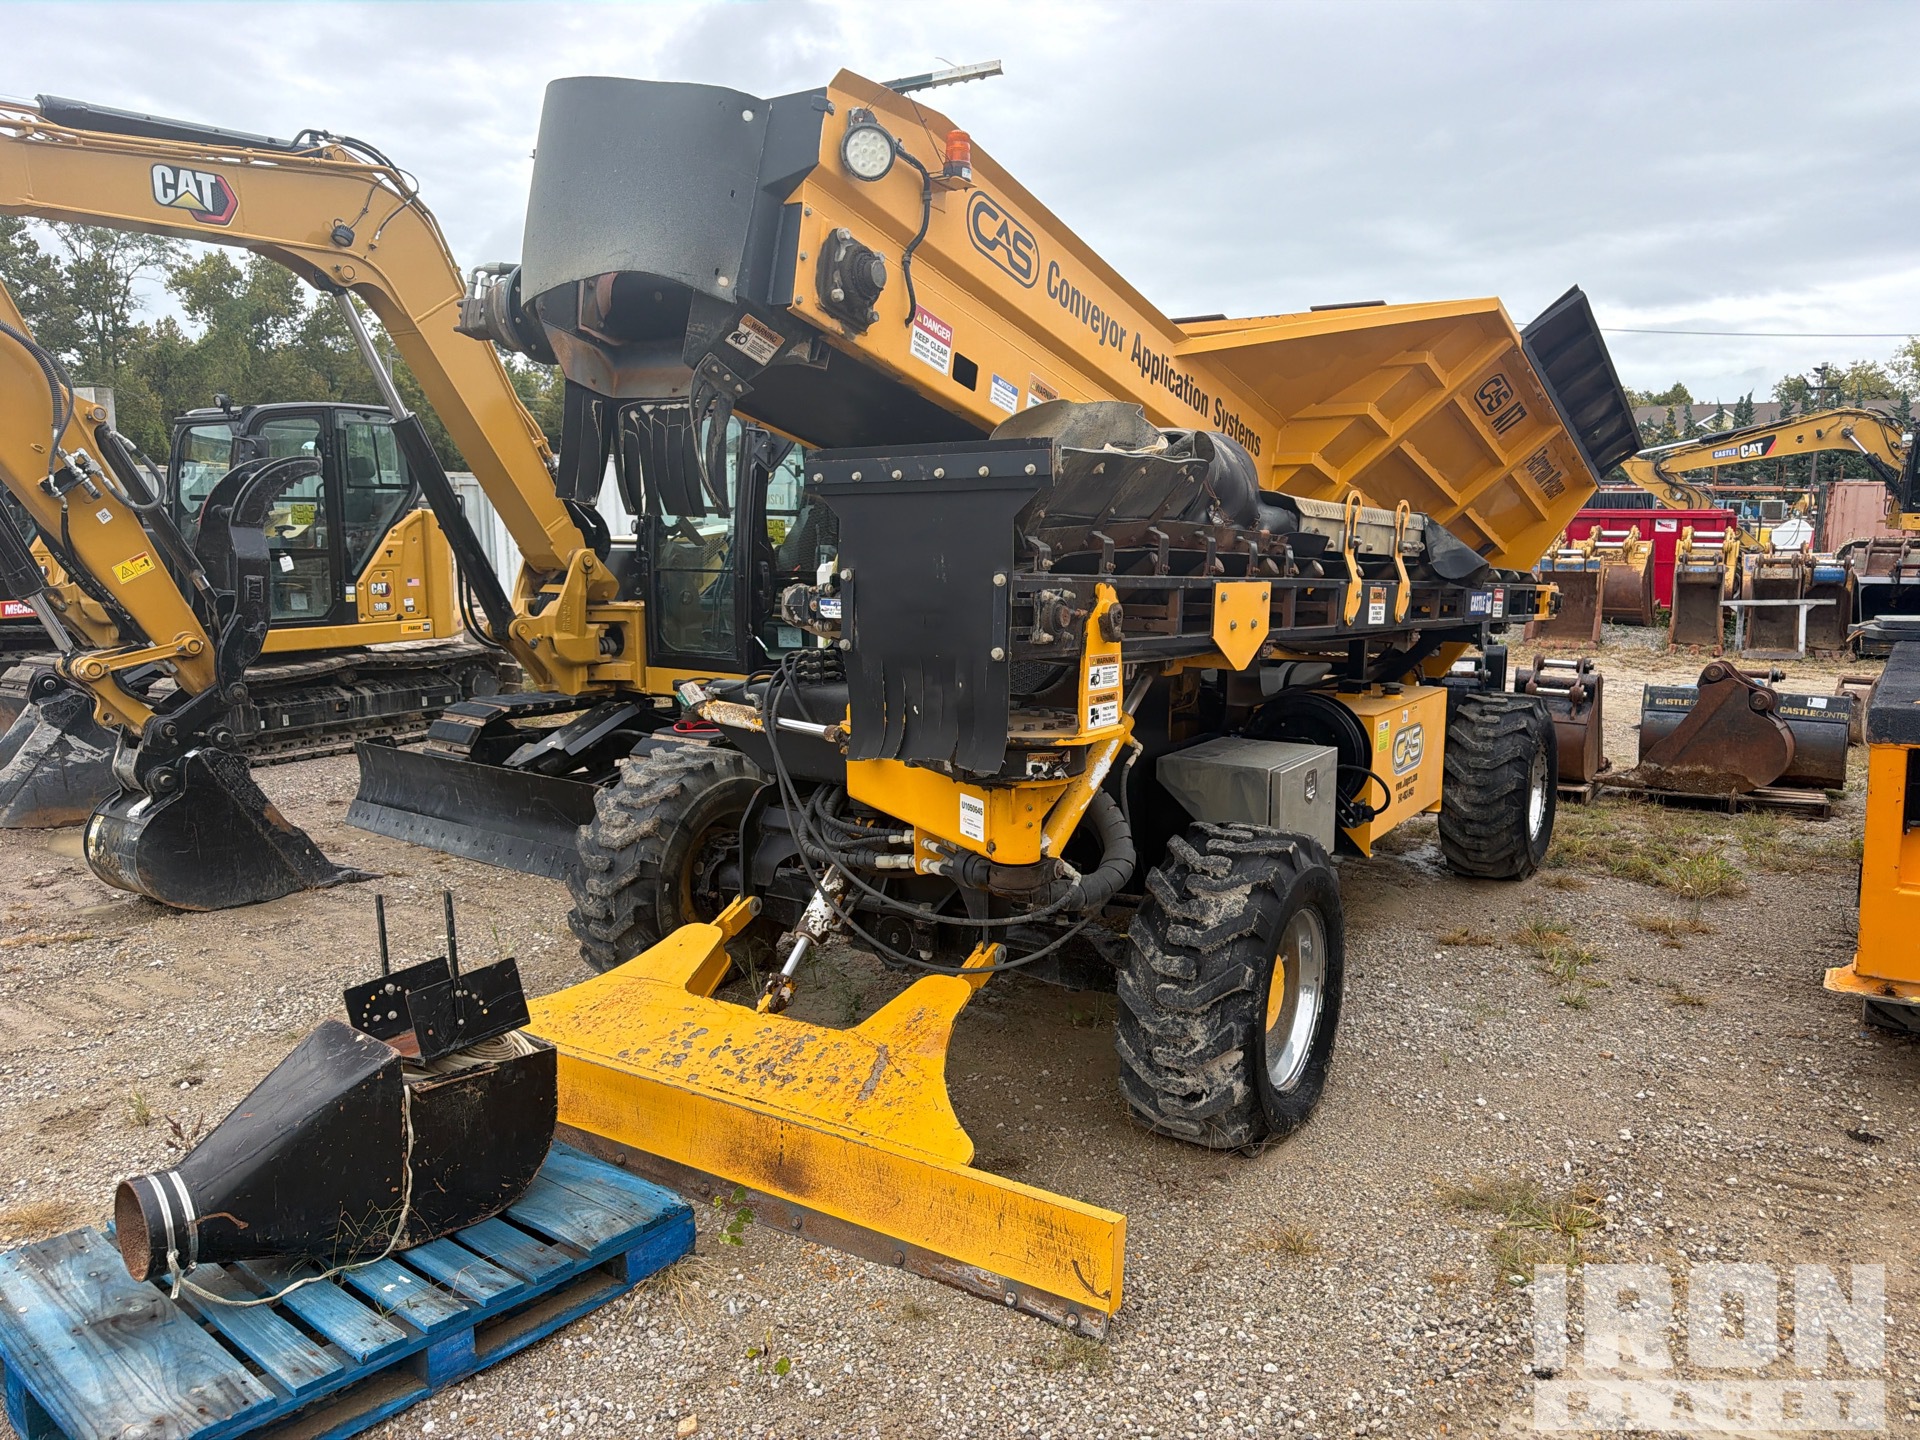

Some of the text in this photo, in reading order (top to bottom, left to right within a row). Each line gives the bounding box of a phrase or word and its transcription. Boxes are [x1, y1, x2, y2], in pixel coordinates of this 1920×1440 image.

[152, 164, 216, 212] CAT
[971, 199, 1035, 281] CAS
[750, 321, 778, 343] WARNING
[922, 313, 951, 342] DANGER
[913, 339, 930, 354] CONVEYOR
[914, 330, 948, 358] KEEP CLEAR
[914, 347, 930, 359] WITHOUT
[1046, 259, 1262, 458] Conveyor Application Systems
[997, 378, 1014, 393] NOTICE
[1478, 377, 1511, 413] CAS
[1714, 442, 1764, 458] CASTLE CAT
[371, 582, 387, 595] CAT
[374, 602, 388, 611] 308
[1096, 656, 1116, 665] WARNING
[1095, 692, 1116, 703] WARNING
[1393, 723, 1422, 769] CAS
